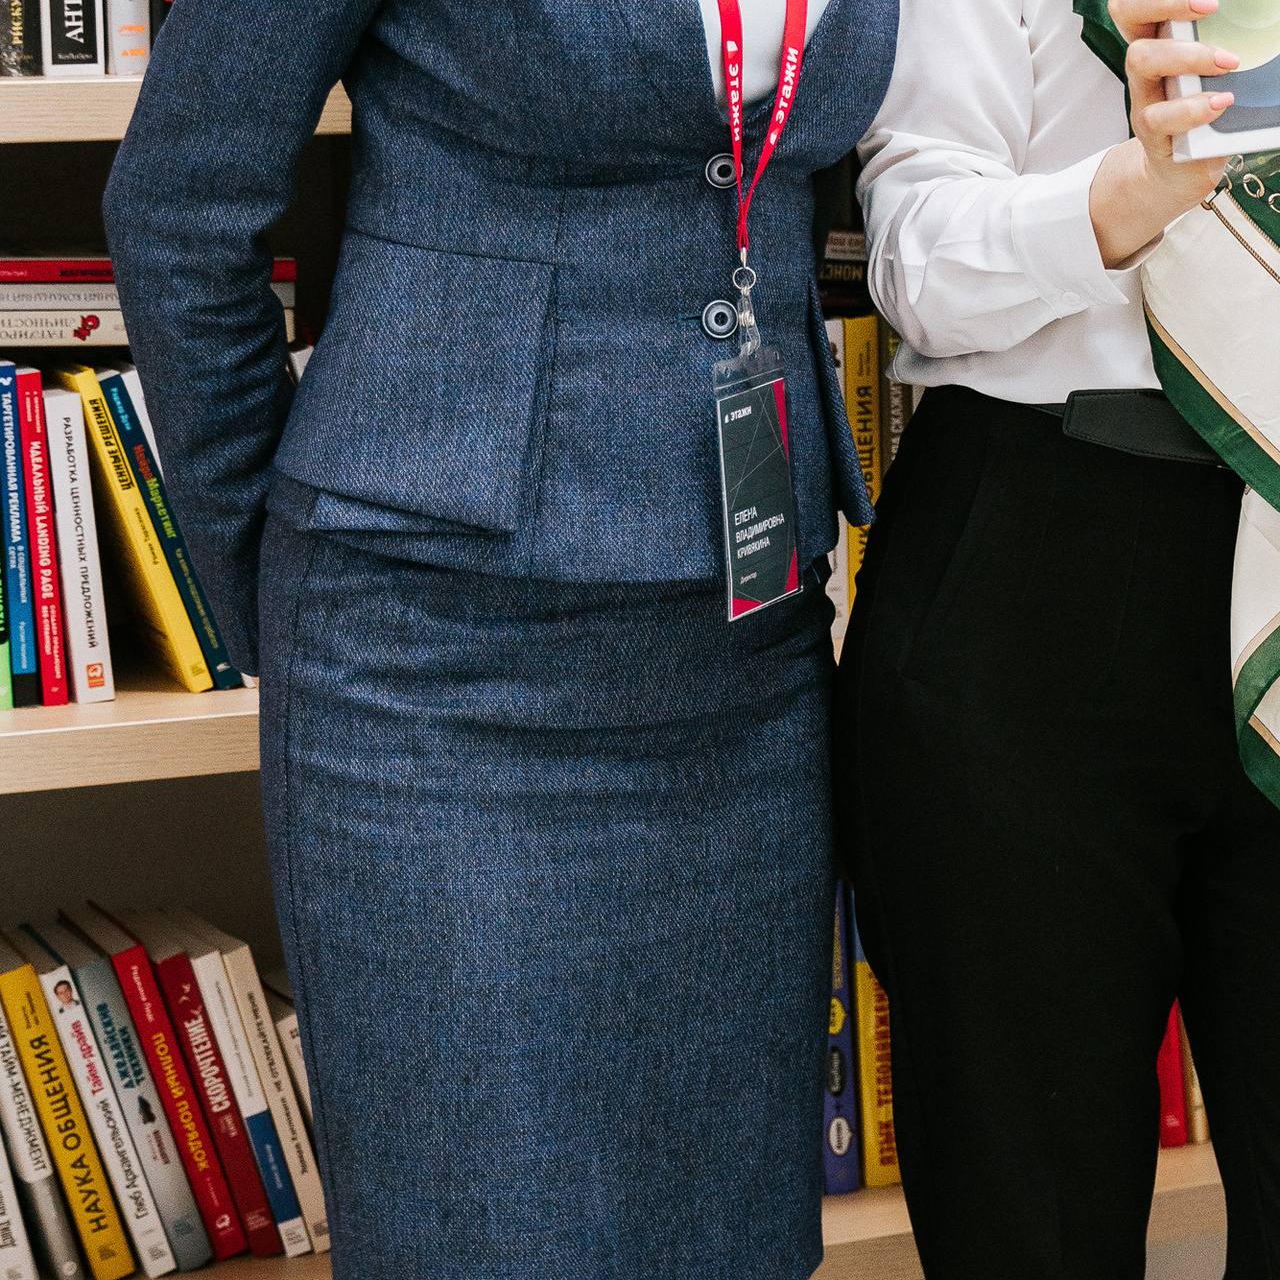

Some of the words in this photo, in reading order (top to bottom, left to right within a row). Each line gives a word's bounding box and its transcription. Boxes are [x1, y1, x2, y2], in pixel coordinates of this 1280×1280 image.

[728, 62, 743, 142] этажи
[774, 46, 799, 125] этажи
[0, 391, 19, 490] ТАРГЕТИРОВАННАЯ
[88, 396, 116, 447] РЕШЕНИЯ
[730, 405, 752, 422] этажи
[30, 441, 45, 513] ИДЕАЛЬНЫЙ
[107, 447, 133, 491] ЦЕННЫЕ
[135, 445, 175, 538] НейроМаркетинг
[7, 491, 22, 543] РЕКЛАМА
[35, 516, 51, 566] LANDING
[63, 416, 77, 482] РАЗРАБОТКА
[70, 487, 86, 561] ЦЕННОСТНЫХ
[81, 566, 96, 648] ПРЕДЛОЖЕНИЙ
[734, 506, 758, 526] ЕЛЕНА
[735, 513, 785, 544] ВЛАДИМИРОВНА
[737, 536, 770, 559] КРИВЯКИНА
[39, 568, 53, 598] PAGE
[94, 1002, 135, 1092] ДЖЕДАЙСКИЕ
[117, 1023, 146, 1086] ТЕХНИКИ
[181, 1014, 233, 1113] СКОРОЧТЕНИЕ
[0, 1042, 46, 1172] ТАЙМ-МЕНЕДЖМЕНТ
[30, 1035, 81, 1151] ОБЩЕНИЯ
[154, 1033, 184, 1098] ПОЛНЫЙ
[173, 1098, 210, 1172] ПОРЯДОК
[100, 1100, 138, 1189] Архангельский
[67, 1154, 108, 1233] НАУКА
[127, 1190, 148, 1219] Глеб
